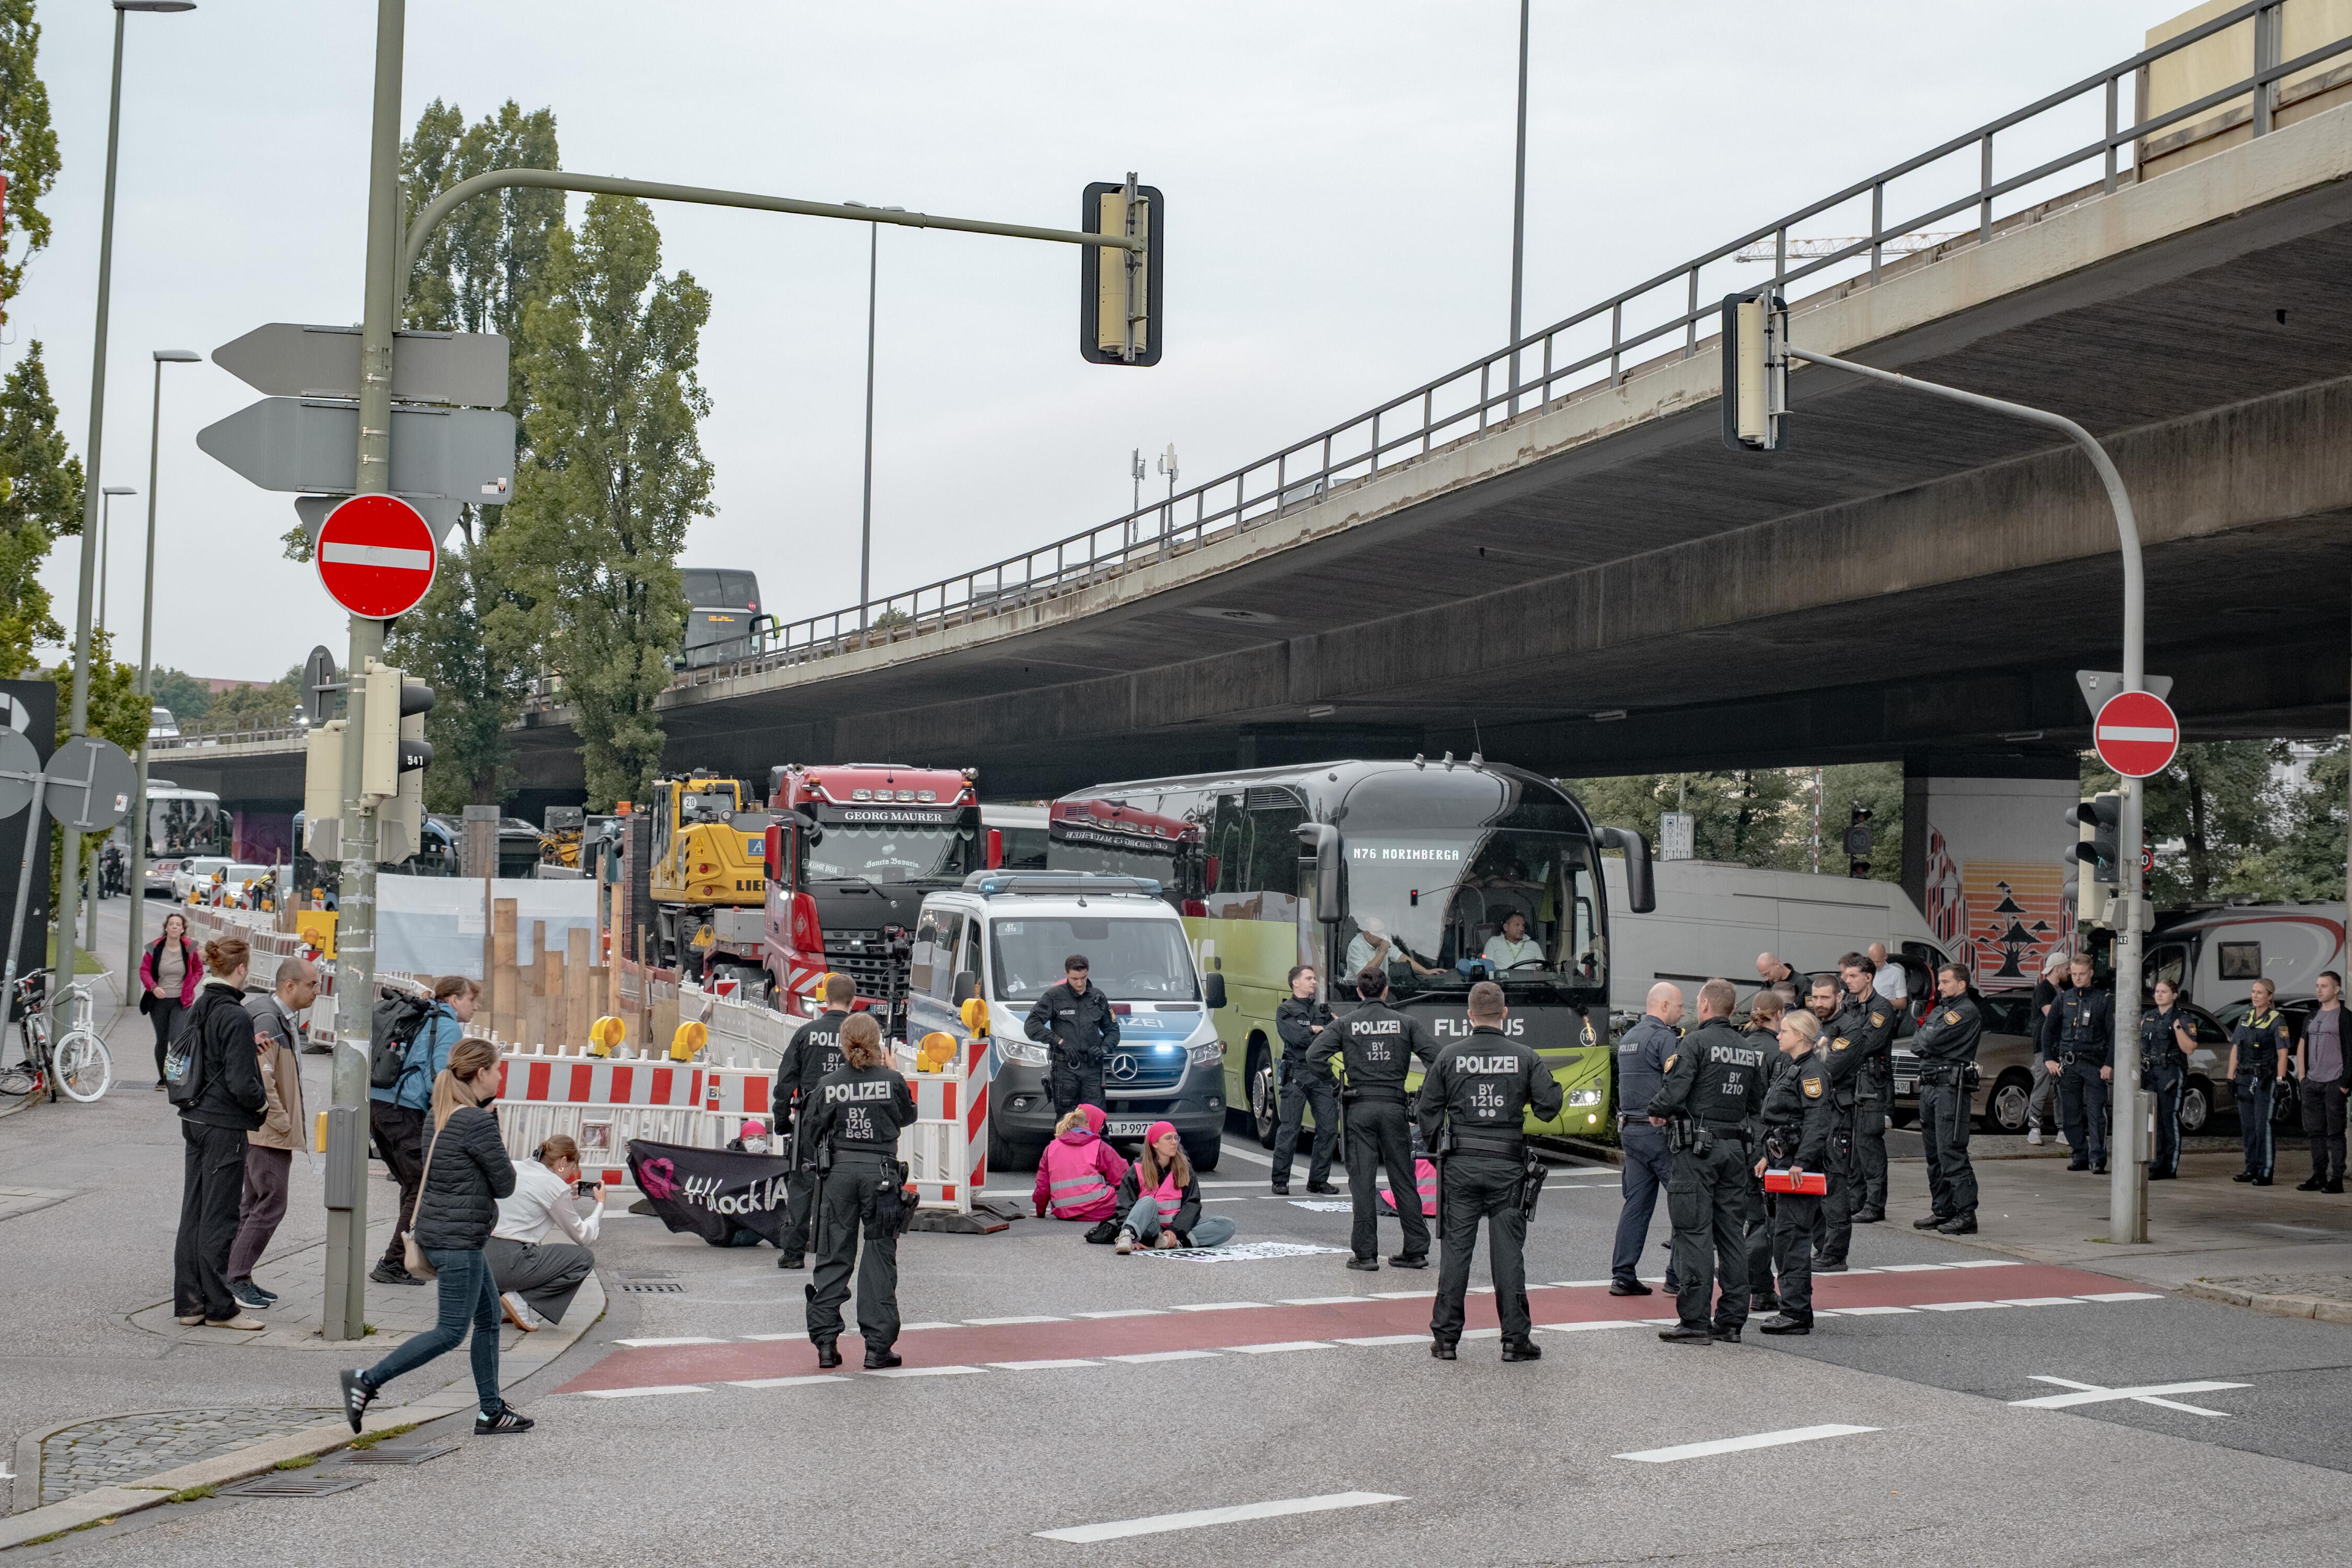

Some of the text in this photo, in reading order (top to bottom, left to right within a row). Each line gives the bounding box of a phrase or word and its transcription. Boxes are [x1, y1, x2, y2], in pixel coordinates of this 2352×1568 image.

[407, 755, 423, 766] 541
[686, 798, 695, 807] 20
[845, 812, 942, 822] GEORG MAURER
[1354, 848, 1459, 860] N76 NORIMBERGA
[825, 866, 837, 874] BUA
[736, 880, 765, 891] LIE
[1119, 1017, 1165, 1029] IZEI
[1351, 1020, 1401, 1035] POLIZEI
[809, 1031, 841, 1047] POLI
[1371, 1042, 1385, 1051] BY
[1619, 1043, 1638, 1053] POLIZEI
[828, 1053, 841, 1063] BY
[1367, 1051, 1391, 1060] 1212
[1711, 1046, 1755, 1067] POLIZEI
[1456, 1056, 1518, 1073] POLIZEI
[1729, 1072, 1742, 1083] BY
[825, 1081, 891, 1103] POLIZEI
[1479, 1083, 1495, 1095] BY
[1722, 1083, 1744, 1095] 1210
[1470, 1095, 1504, 1107] 1216
[848, 1108, 867, 1119] BY
[845, 1119, 871, 1129] 1216
[1121, 1124, 1127, 1134] P
[1129, 1124, 1155, 1134] 997
[846, 1128, 873, 1139] BeSi
